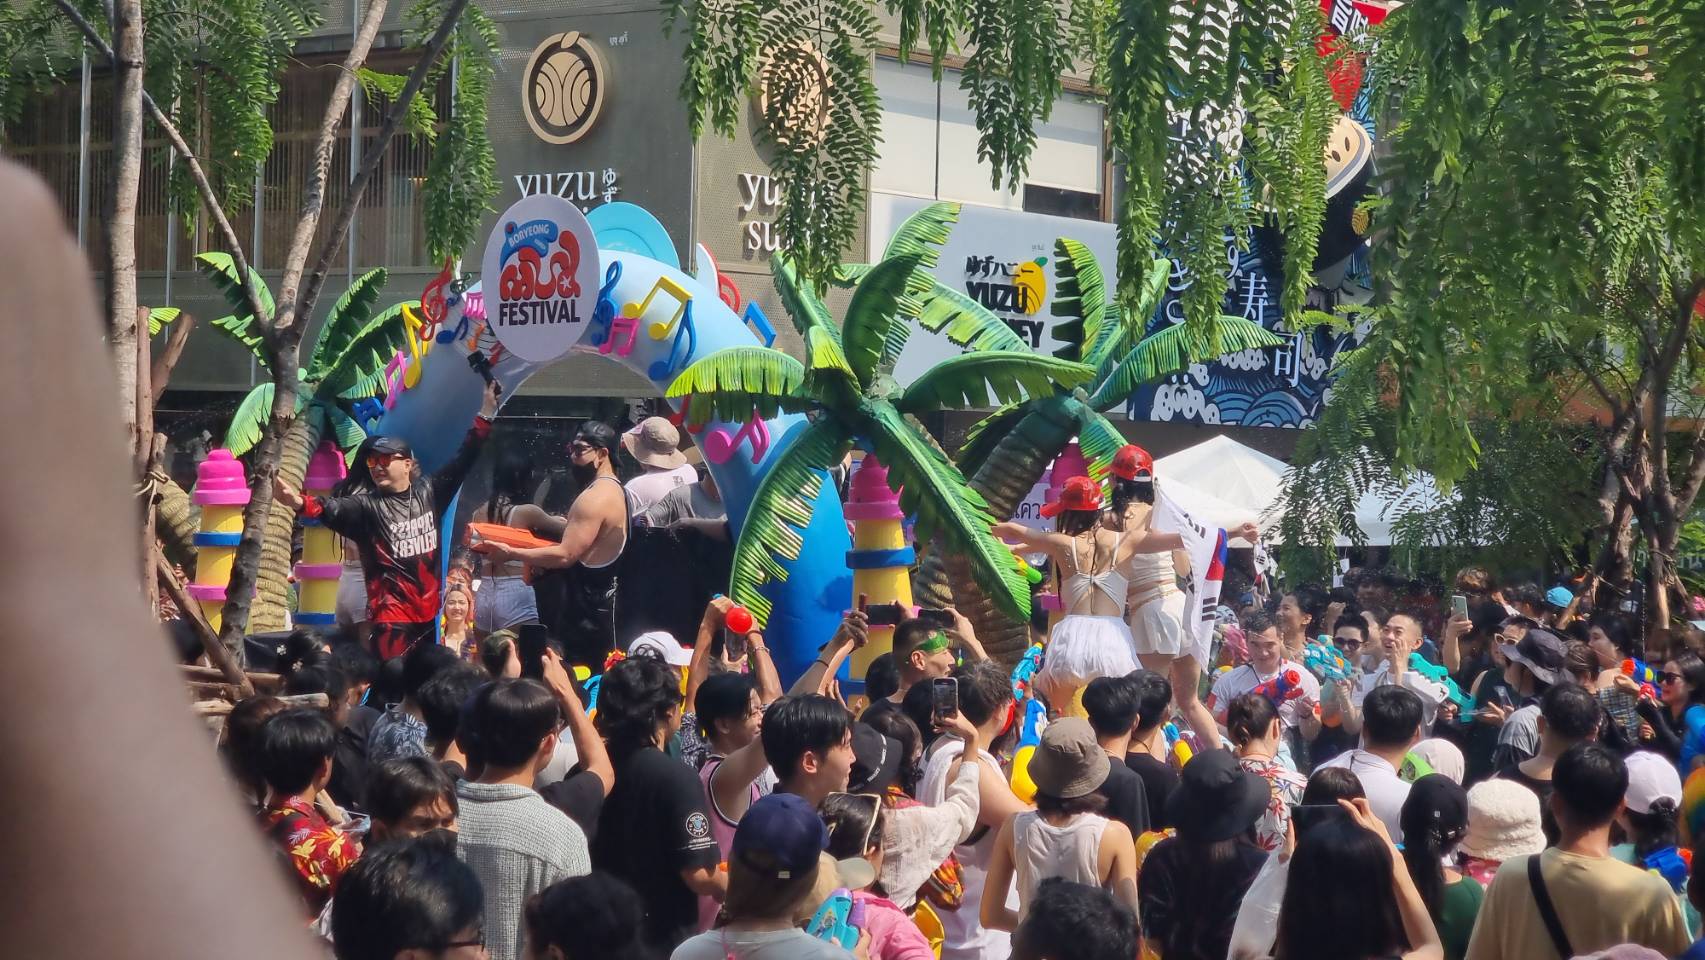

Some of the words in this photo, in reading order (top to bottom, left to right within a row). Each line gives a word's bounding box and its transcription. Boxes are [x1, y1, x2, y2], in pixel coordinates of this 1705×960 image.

[514, 171, 598, 200] yuzu
[508, 224, 550, 247] BORYEONG
[966, 281, 1028, 313] YUZU
[499, 300, 581, 326] FESTIVAL
